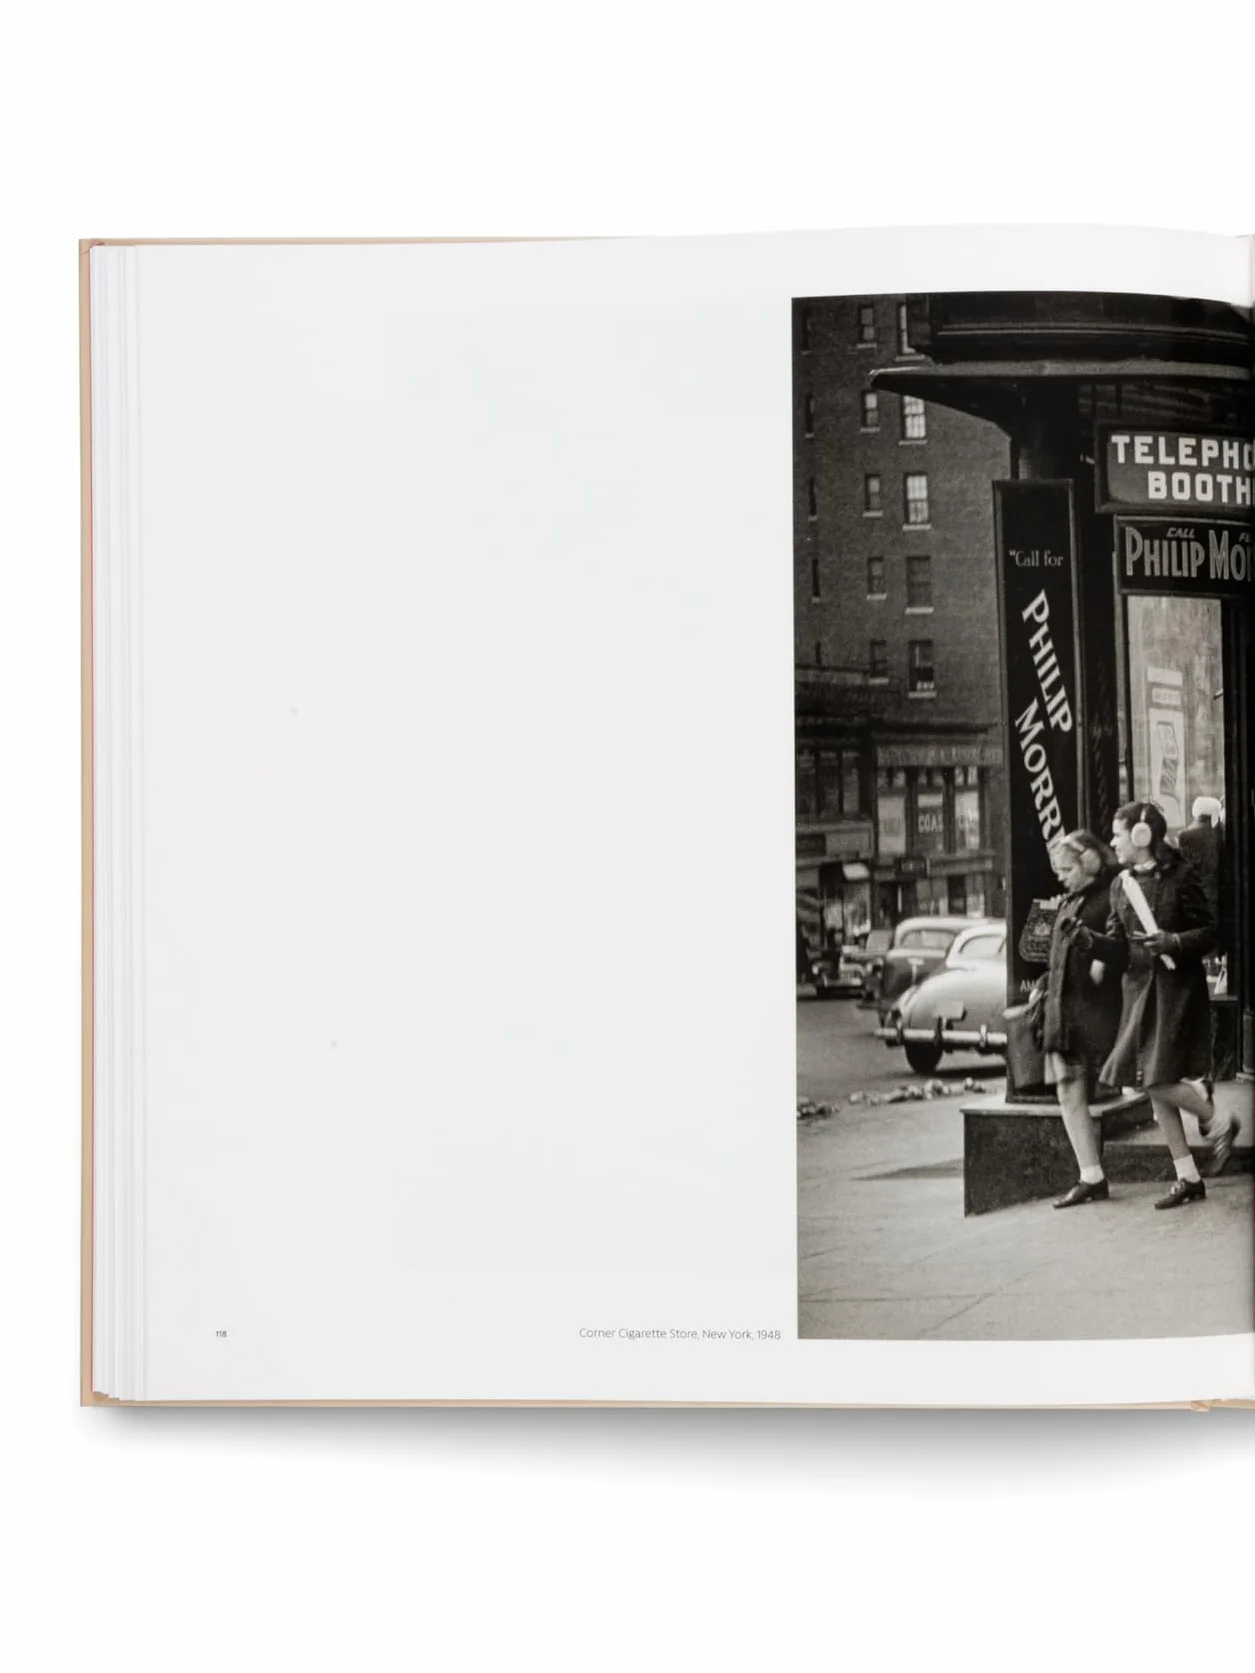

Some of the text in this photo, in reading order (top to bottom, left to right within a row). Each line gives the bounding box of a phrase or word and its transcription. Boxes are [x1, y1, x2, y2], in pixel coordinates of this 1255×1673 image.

[1166, 526, 1196, 539] CALL
[1043, 548, 1064, 568] for
[1124, 526, 1206, 578] PHILIP
[1021, 587, 1074, 734] PHILIP
[1014, 697, 1067, 860] MORRI
[578, 1327, 782, 1342] Corner Cigarette Store, New York, 1948
